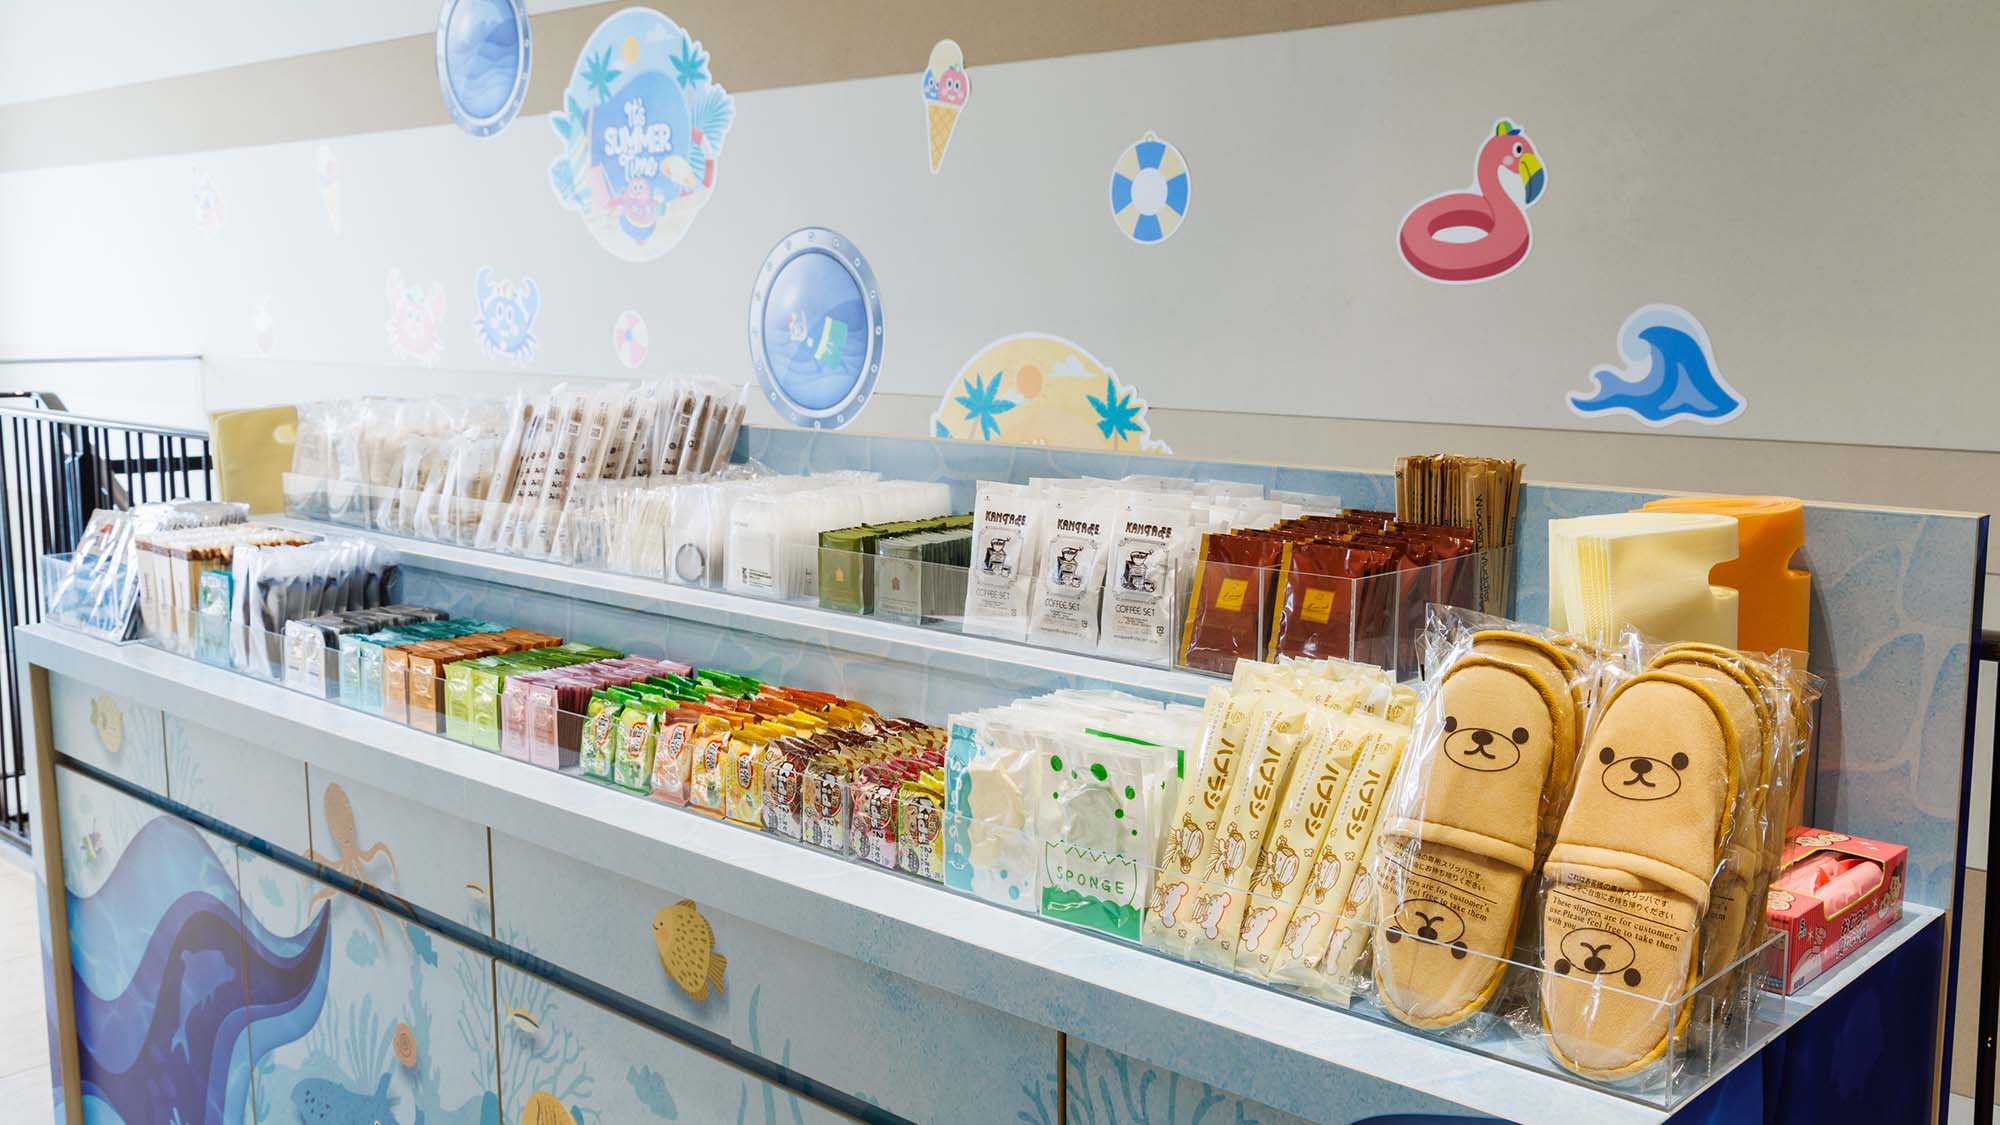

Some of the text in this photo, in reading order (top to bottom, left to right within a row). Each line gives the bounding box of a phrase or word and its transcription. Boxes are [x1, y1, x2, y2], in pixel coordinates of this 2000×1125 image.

[604, 123, 673, 156] SUMMER
[1044, 598, 1080, 611] COFFEE SET
[1115, 604, 1155, 617] COFFEE SET
[1203, 737, 1235, 810] ハブラシ
[1249, 745, 1281, 819] ハブラシ
[1304, 763, 1339, 838] ハブラシ
[1346, 769, 1381, 840] ハブラシ
[1056, 865, 1126, 895] SPONGE
[1422, 881, 1434, 891] are
[1436, 885, 1448, 896] for
[1449, 890, 1490, 913] customer's
[1422, 890, 1439, 900] free
[1440, 897, 1448, 906] to
[1450, 901, 1466, 912] take
[1467, 907, 1488, 921] them
[1547, 916, 1561, 926] with
[1553, 896, 1680, 942] These slippers are for customer's
[1586, 917, 1602, 928] feel
[1604, 923, 1622, 935] free
[1623, 929, 1632, 937] to
[1635, 931, 1653, 944] take
[1656, 938, 1678, 952] them
